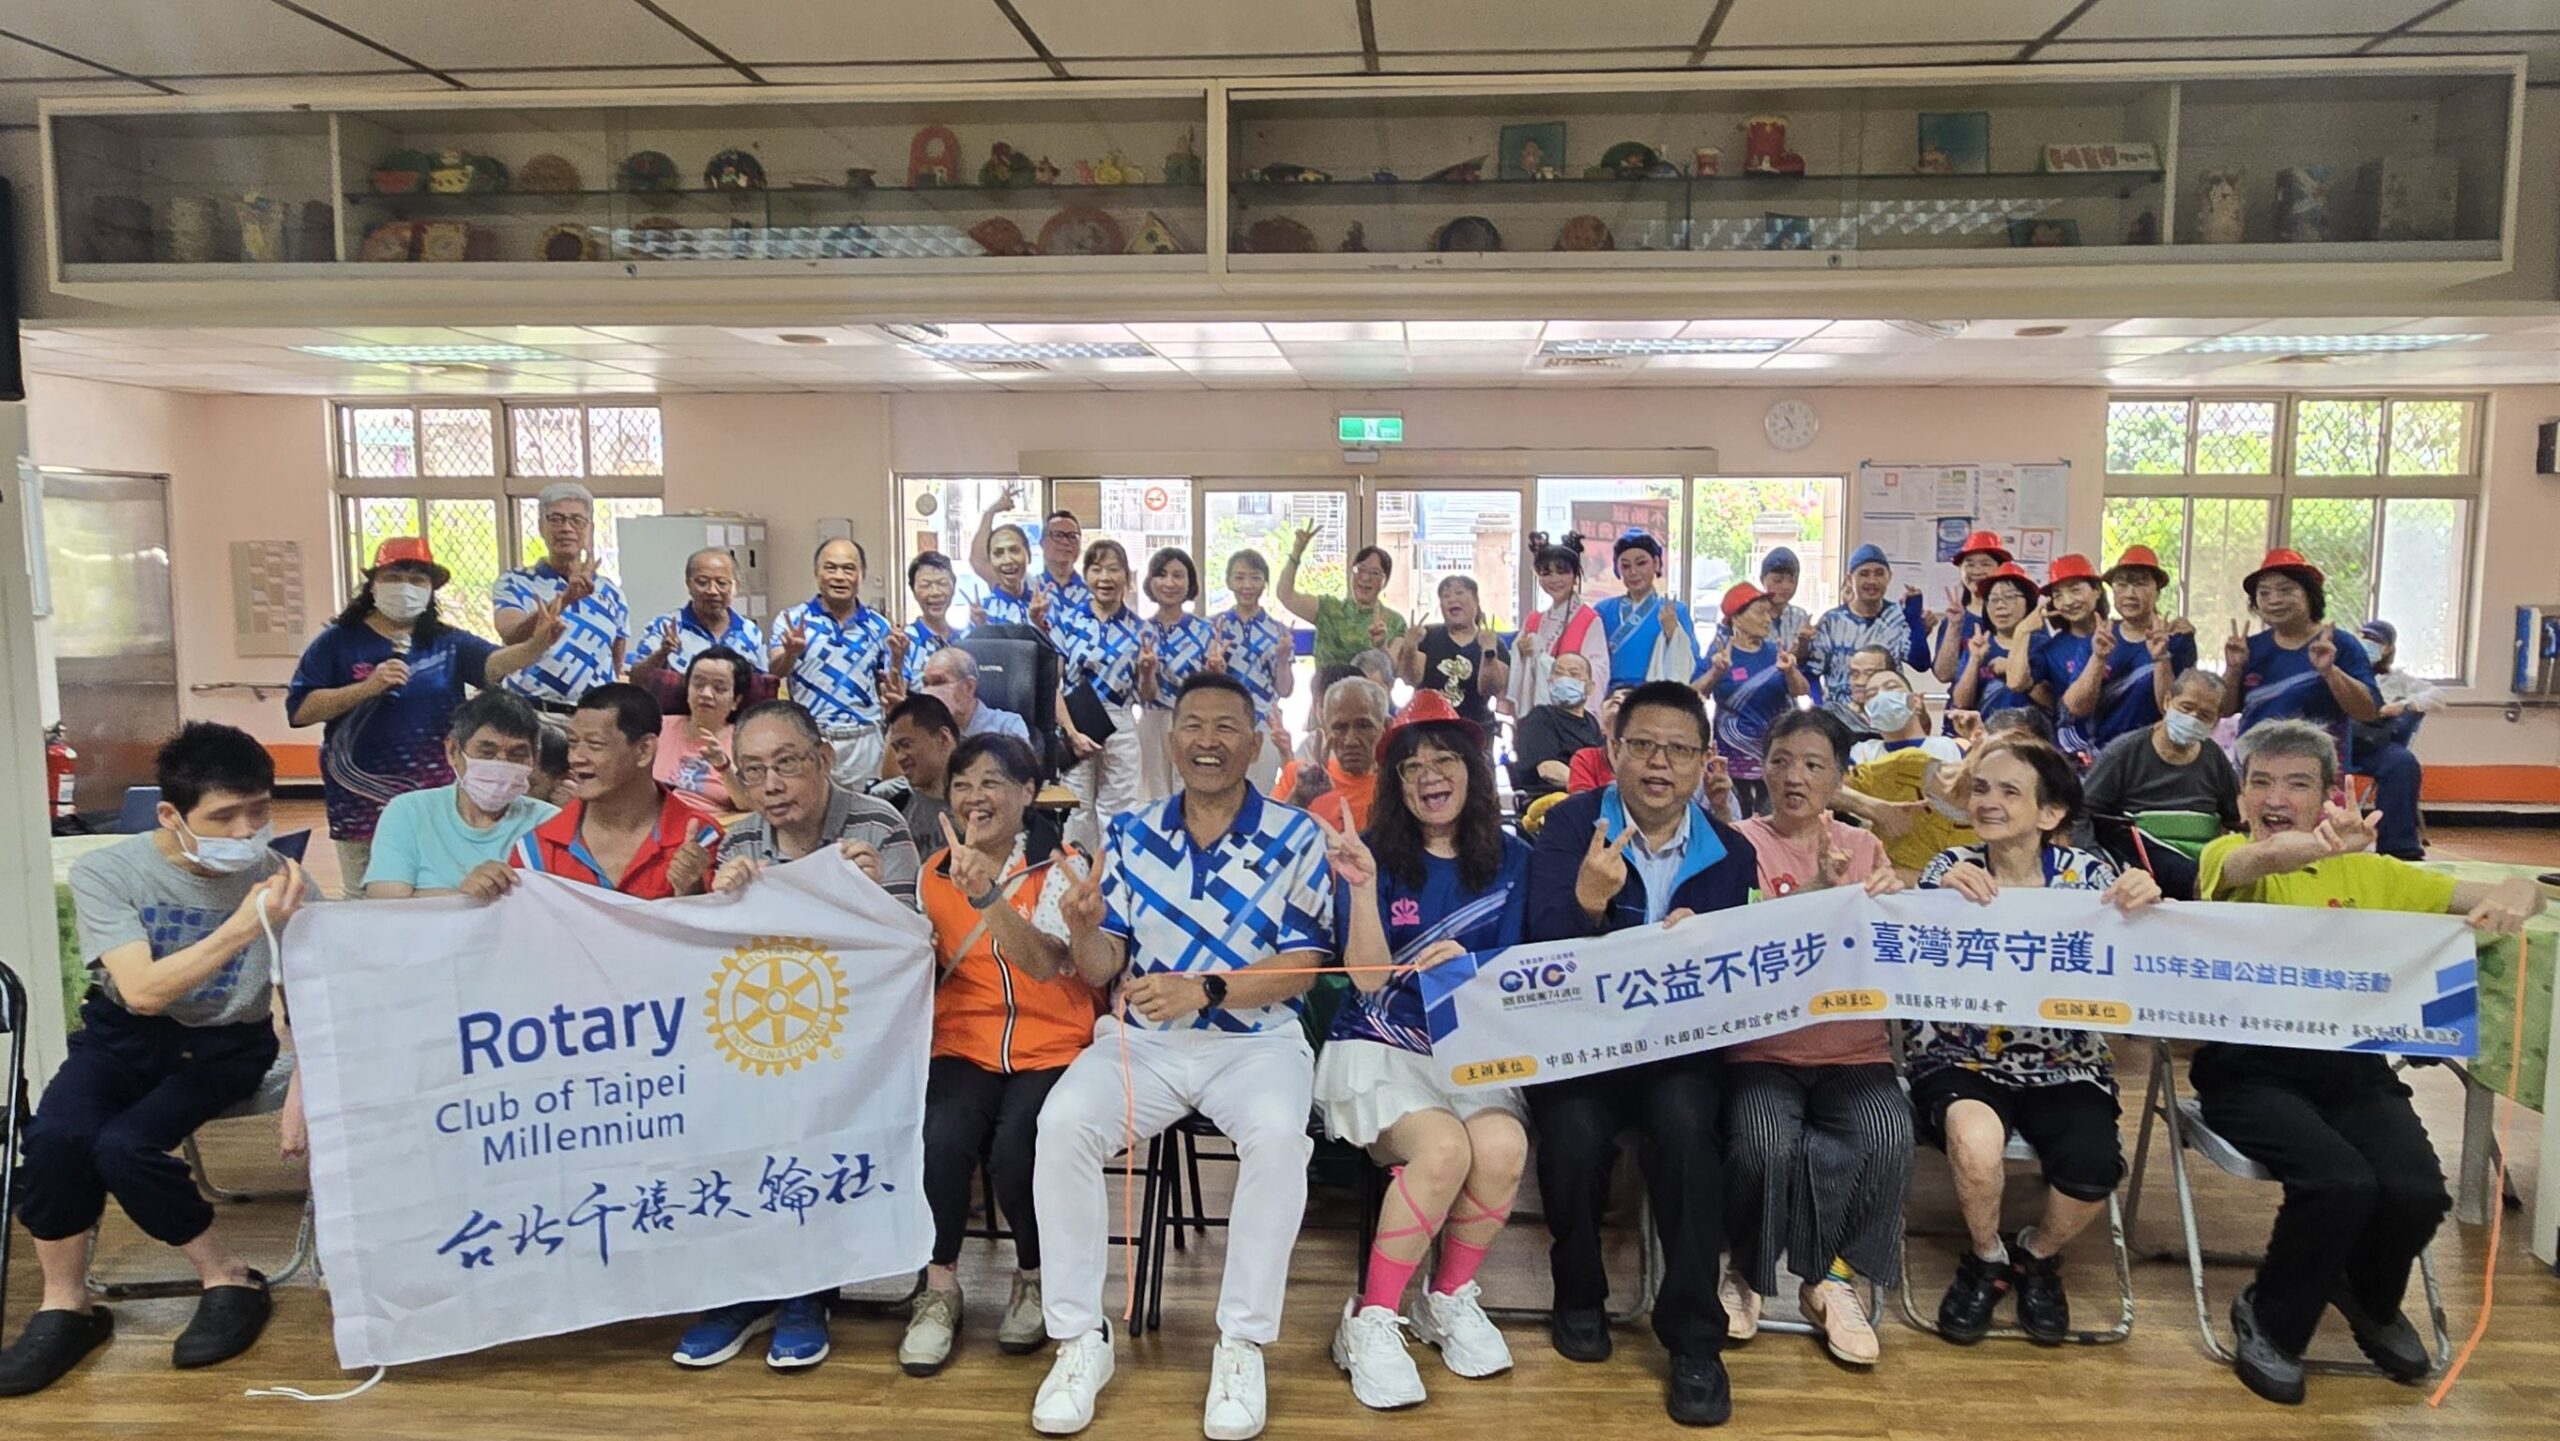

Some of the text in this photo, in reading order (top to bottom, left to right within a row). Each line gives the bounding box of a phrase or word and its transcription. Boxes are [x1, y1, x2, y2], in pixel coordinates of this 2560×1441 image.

[1499, 963, 1566, 992] CYC
[2134, 954, 2392, 993] 115年全國公益日連線活動
[1820, 992, 1873, 1008] 承辦單位
[2053, 1001, 2118, 1018] 協辦單位
[458, 996, 686, 1075] Rotary
[729, 1016, 829, 1059] INTERNATIONAL
[1466, 1063, 1526, 1081] 主辦單位
[435, 1065, 686, 1134] Club of Taipei
[482, 1111, 685, 1166] Millennium
